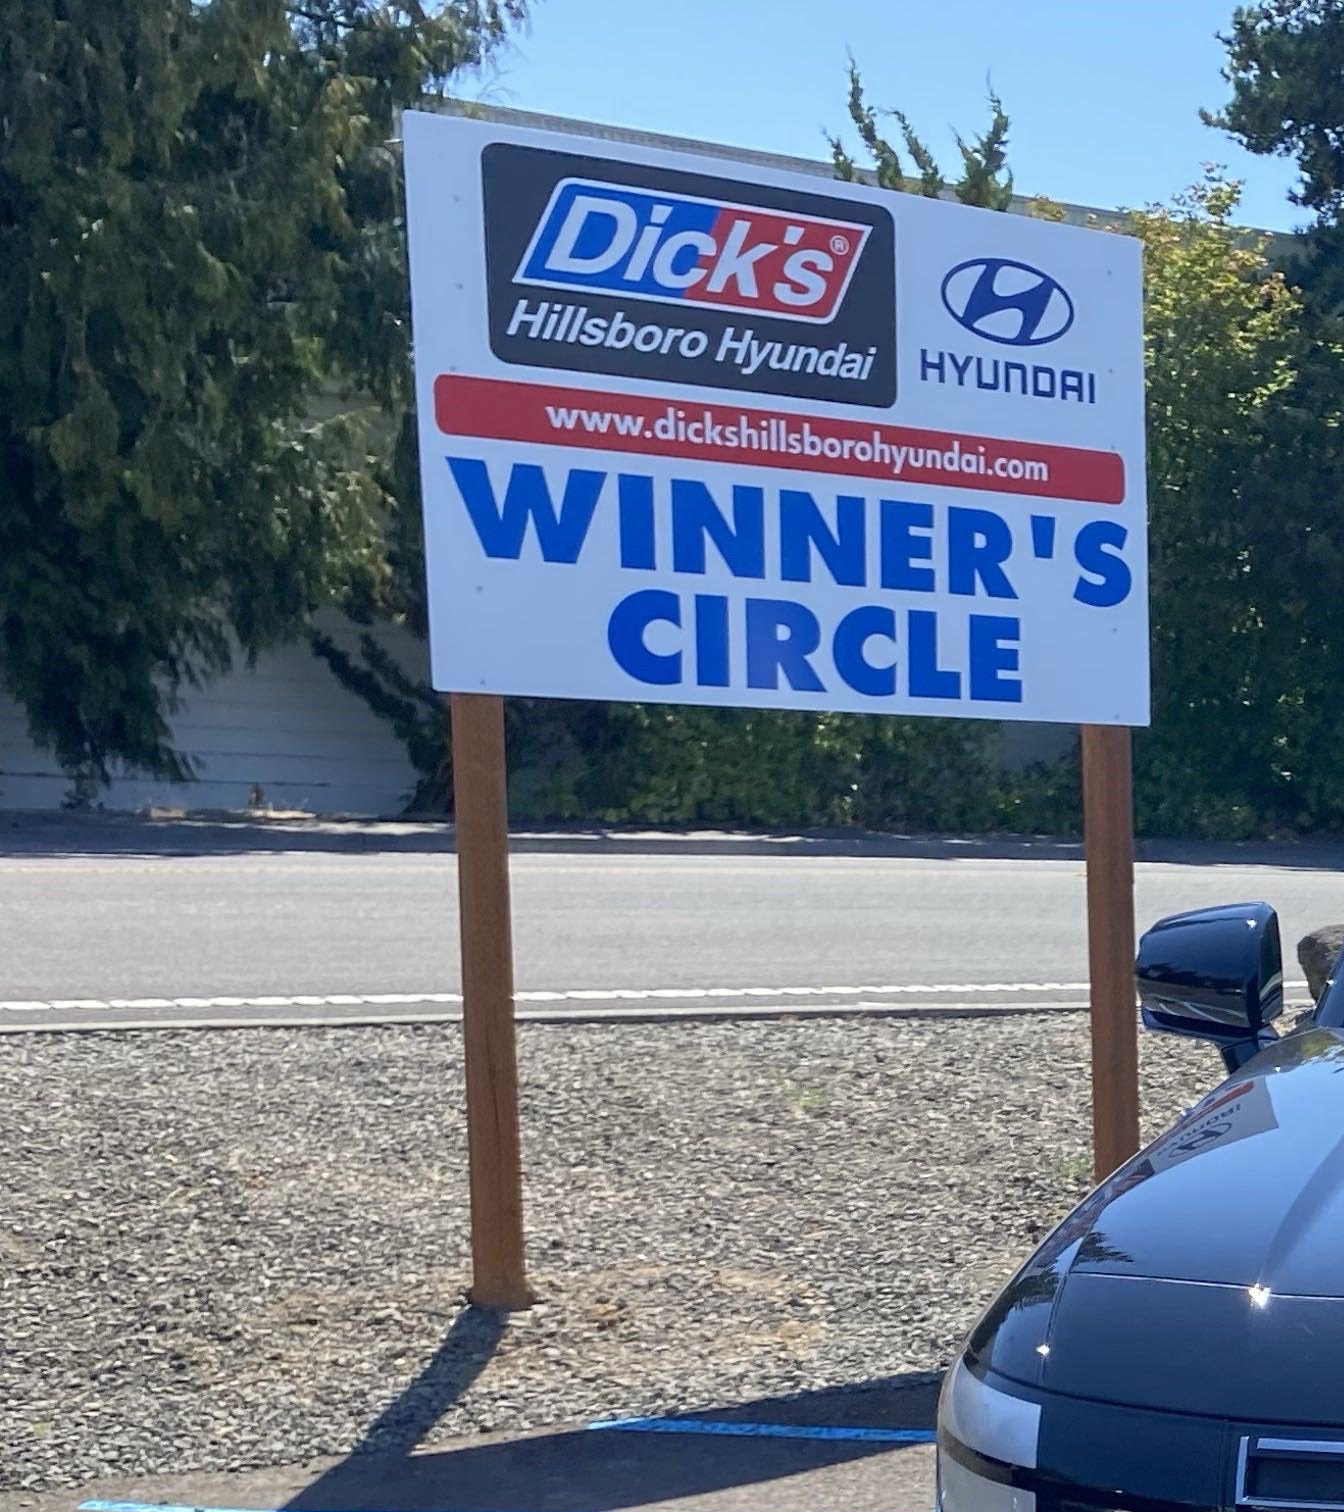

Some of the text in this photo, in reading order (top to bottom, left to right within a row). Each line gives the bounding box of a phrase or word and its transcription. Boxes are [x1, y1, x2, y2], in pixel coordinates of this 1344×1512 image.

[545, 195, 833, 307] Dick's
[507, 299, 877, 380] Hillsboro Hyundai
[920, 348, 1096, 404] HYUNDAI
[546, 403, 1049, 483] www.dickshillsborohyundai.com
[446, 456, 1133, 608] WINNER'S
[608, 588, 1023, 702] CIRCLE
